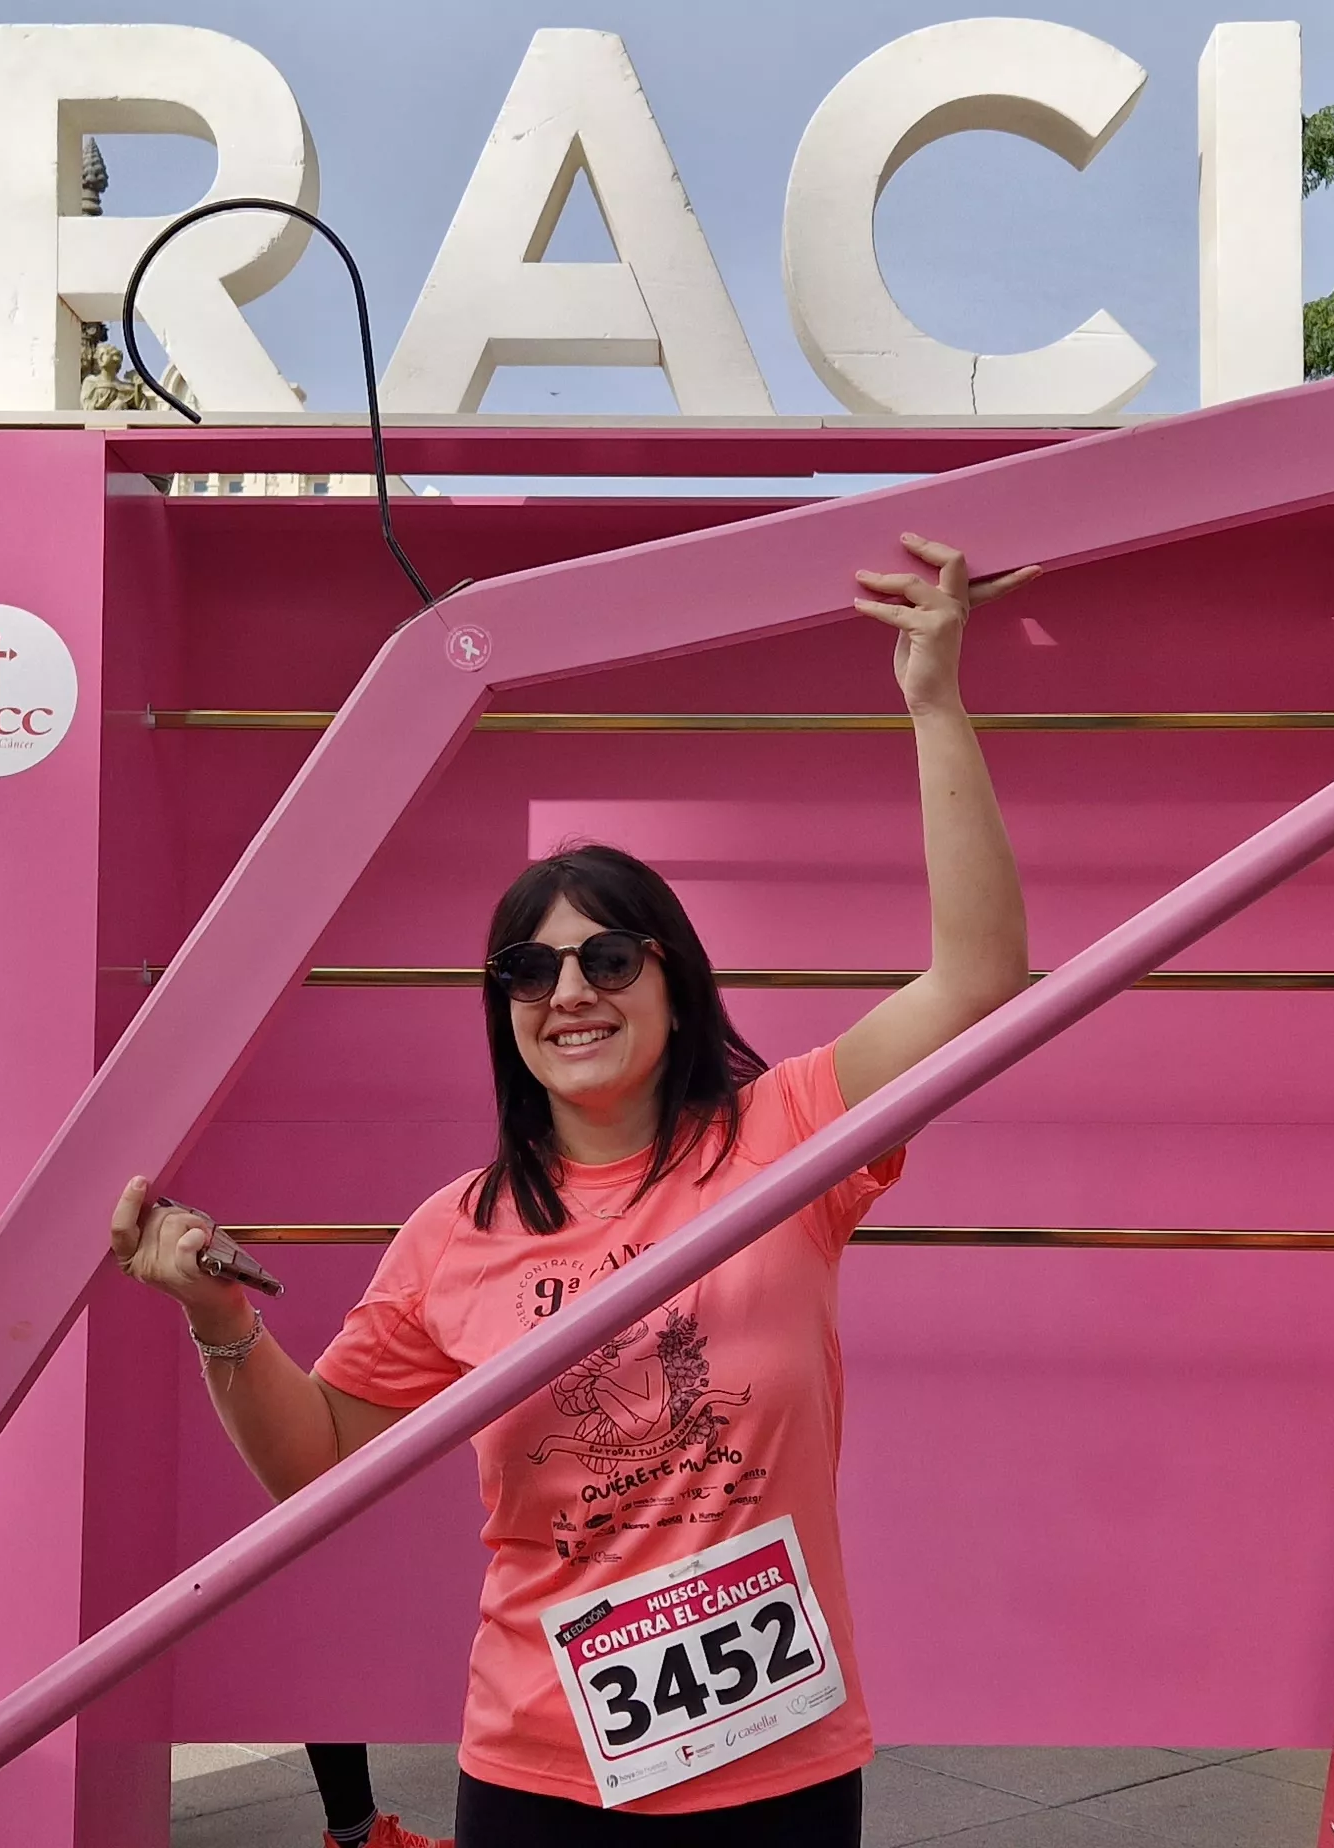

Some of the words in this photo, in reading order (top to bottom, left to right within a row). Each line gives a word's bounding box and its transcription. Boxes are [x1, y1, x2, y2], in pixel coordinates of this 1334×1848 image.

[519, 1259, 567, 1288] CONTRA
[679, 1446, 742, 1474] MUCHO
[647, 1579, 710, 1612] HUESCA
[571, 1607, 606, 1637] EDICIÓN
[580, 1613, 671, 1659] CONTRA
[673, 1603, 699, 1626] EL
[702, 1567, 784, 1615] CÁNCER
[589, 1601, 814, 1746] 3452
[738, 1712, 779, 1739] castellar
